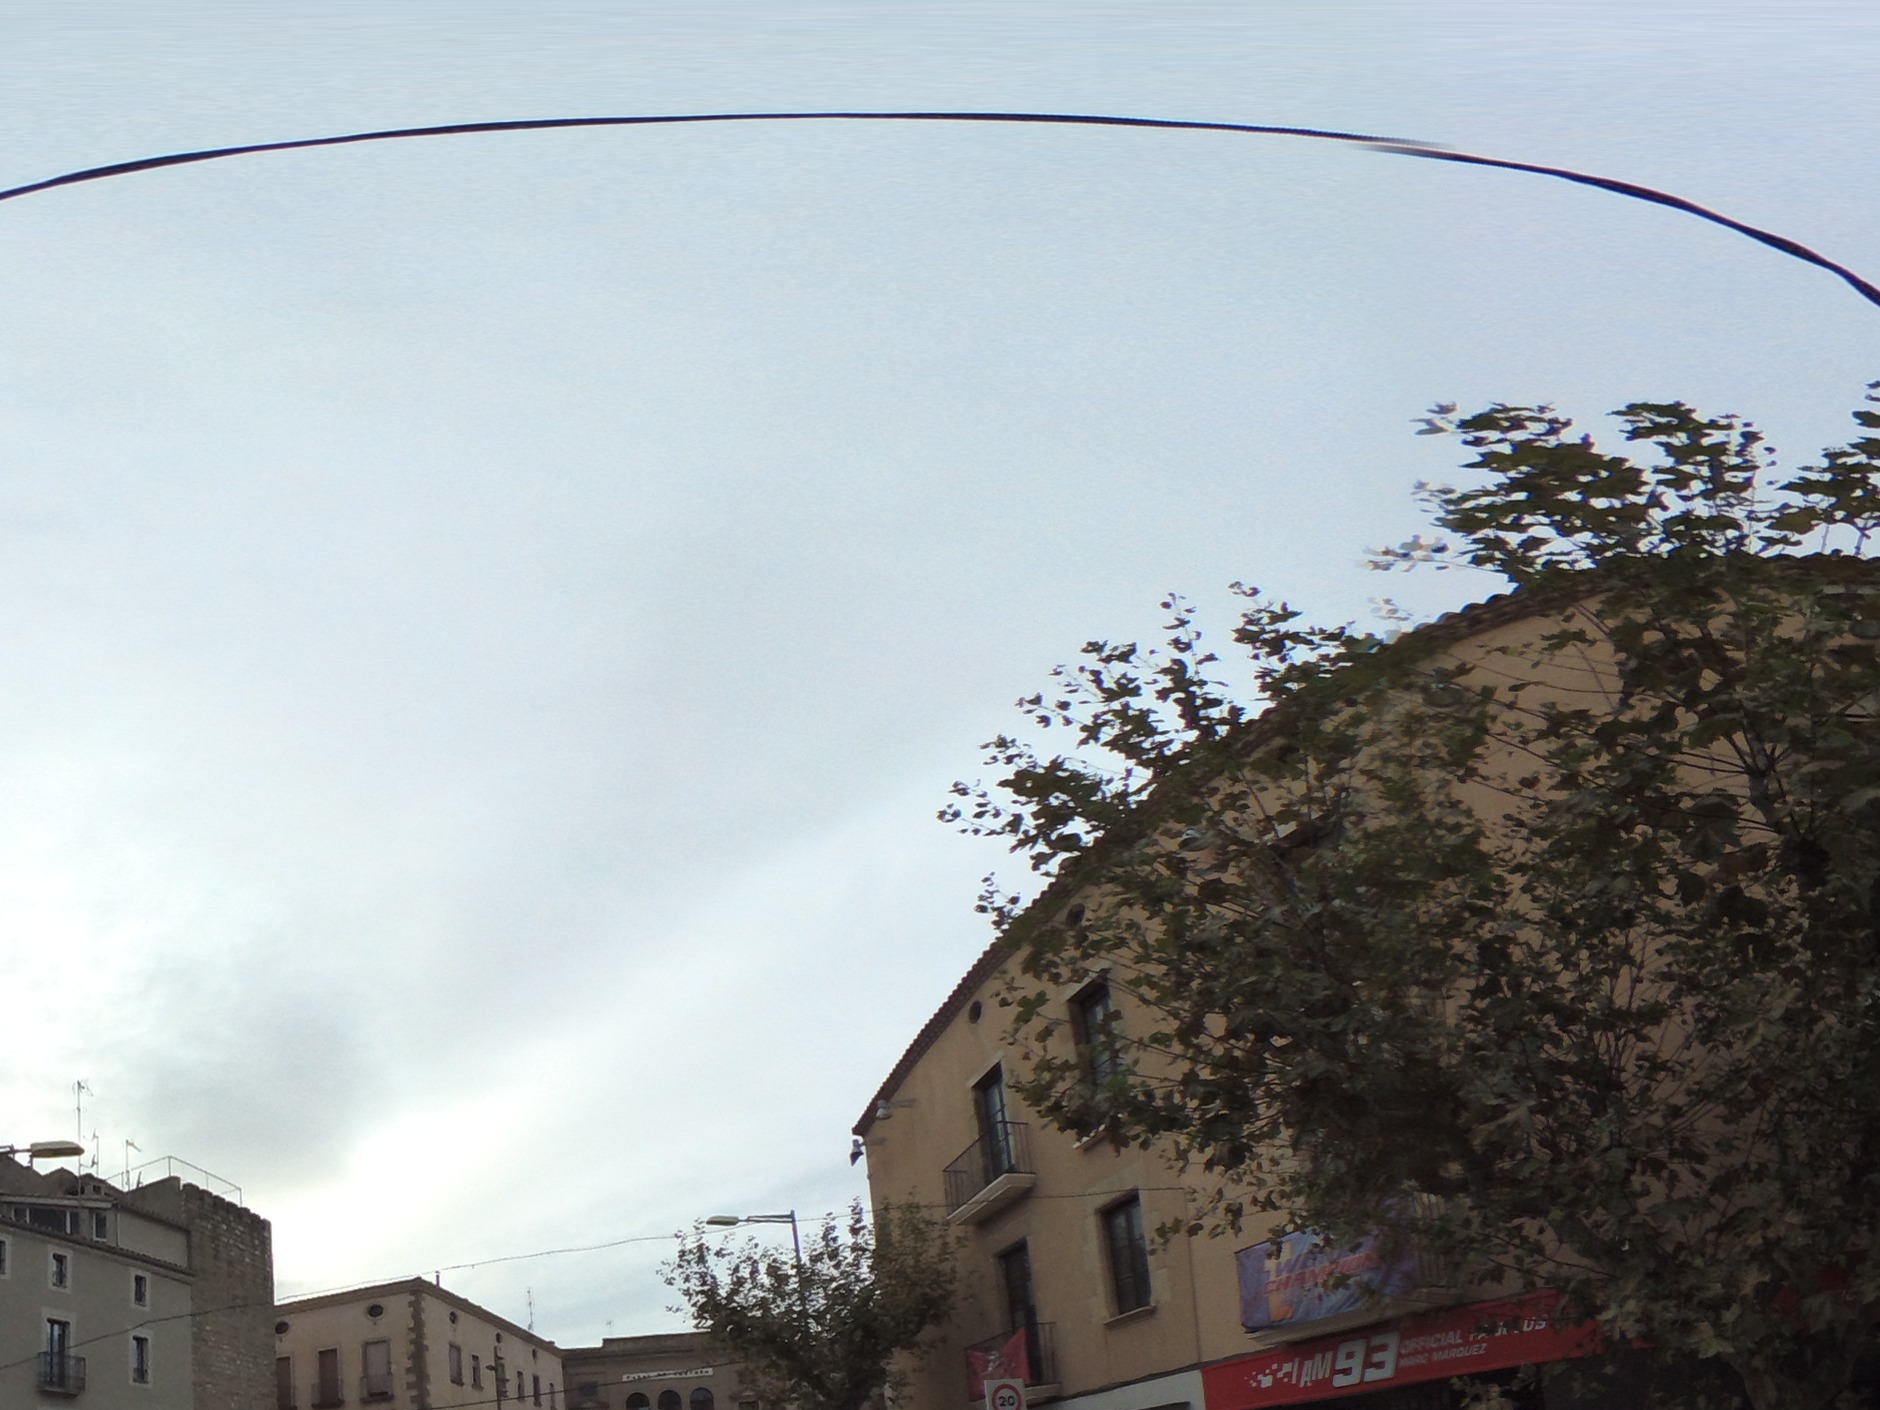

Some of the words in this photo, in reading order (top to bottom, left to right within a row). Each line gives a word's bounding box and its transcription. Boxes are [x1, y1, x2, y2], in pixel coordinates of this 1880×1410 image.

[1399, 1329, 1463, 1355] OFFICIAL
[1431, 1343, 1489, 1362] MARQUEZ
[1299, 1351, 1333, 1388] AM
[1332, 1331, 1400, 1388] 93
[998, 1395, 1015, 1407] 20
